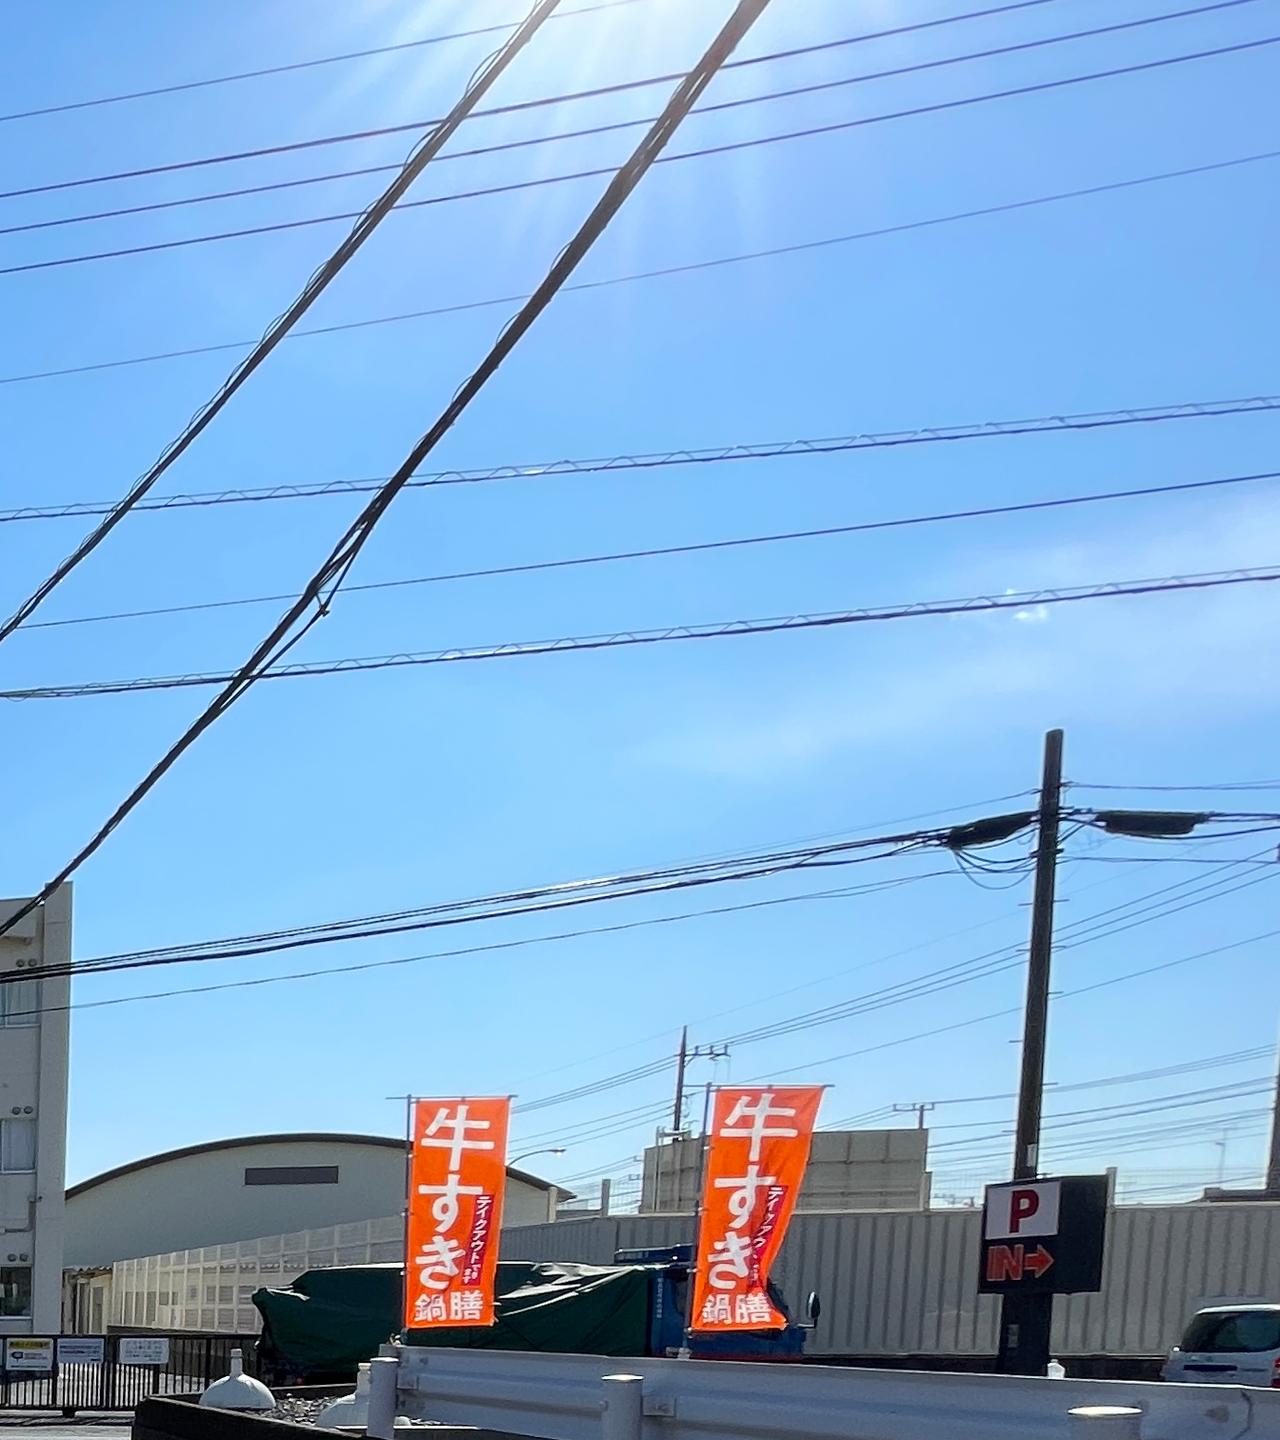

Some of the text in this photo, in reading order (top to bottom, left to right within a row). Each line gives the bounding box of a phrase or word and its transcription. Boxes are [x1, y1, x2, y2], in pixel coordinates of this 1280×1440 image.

[415, 1104, 495, 1290] 牛すき
[707, 1093, 799, 1290] 牛すき
[1009, 1189, 1039, 1234] P
[986, 1244, 1025, 1282] IN
[414, 1290, 484, 1323] 鍋膳
[702, 1291, 773, 1324] 鍋膳
